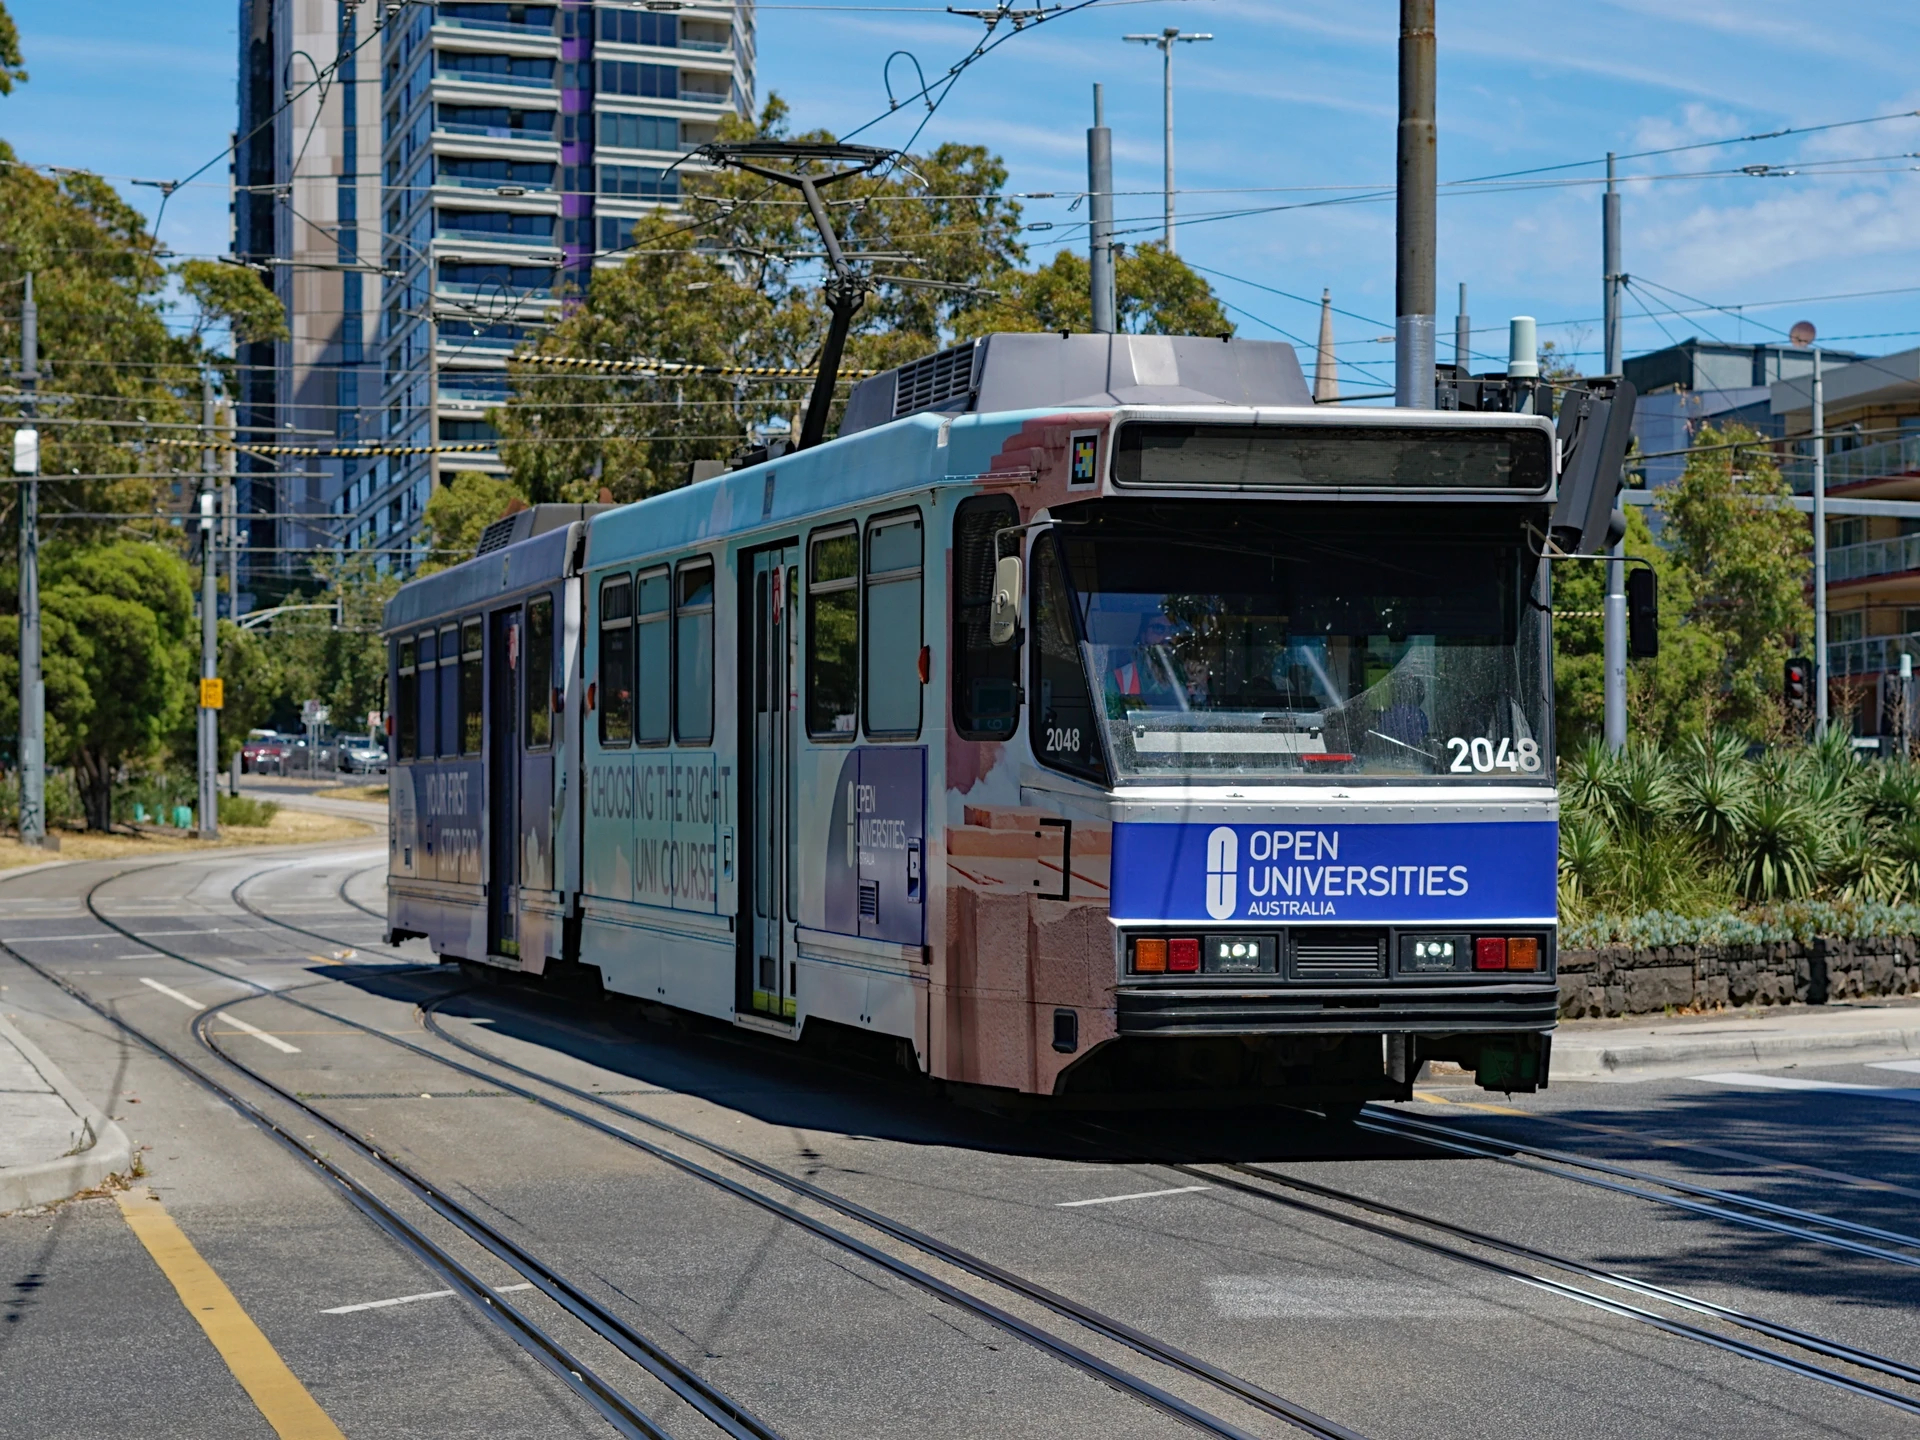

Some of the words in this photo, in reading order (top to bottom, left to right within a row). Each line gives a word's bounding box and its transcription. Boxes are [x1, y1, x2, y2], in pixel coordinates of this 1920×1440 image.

[1046, 727, 1081, 753] 2048
[1447, 737, 1541, 774] 2048
[425, 772, 447, 815] YOUR
[448, 771, 469, 815] FIRST
[591, 764, 654, 820] CHOOSING
[657, 765, 682, 822] THE
[686, 765, 731, 825] RIGHT
[441, 828, 461, 872] STOP
[462, 829, 479, 873] FOR
[1249, 830, 1339, 861] OPEN
[634, 838, 657, 894] UNI
[661, 840, 717, 902] COURSE
[1248, 865, 1469, 897] UNIVERSITIES
[1247, 900, 1336, 917] AUSTRALIA
